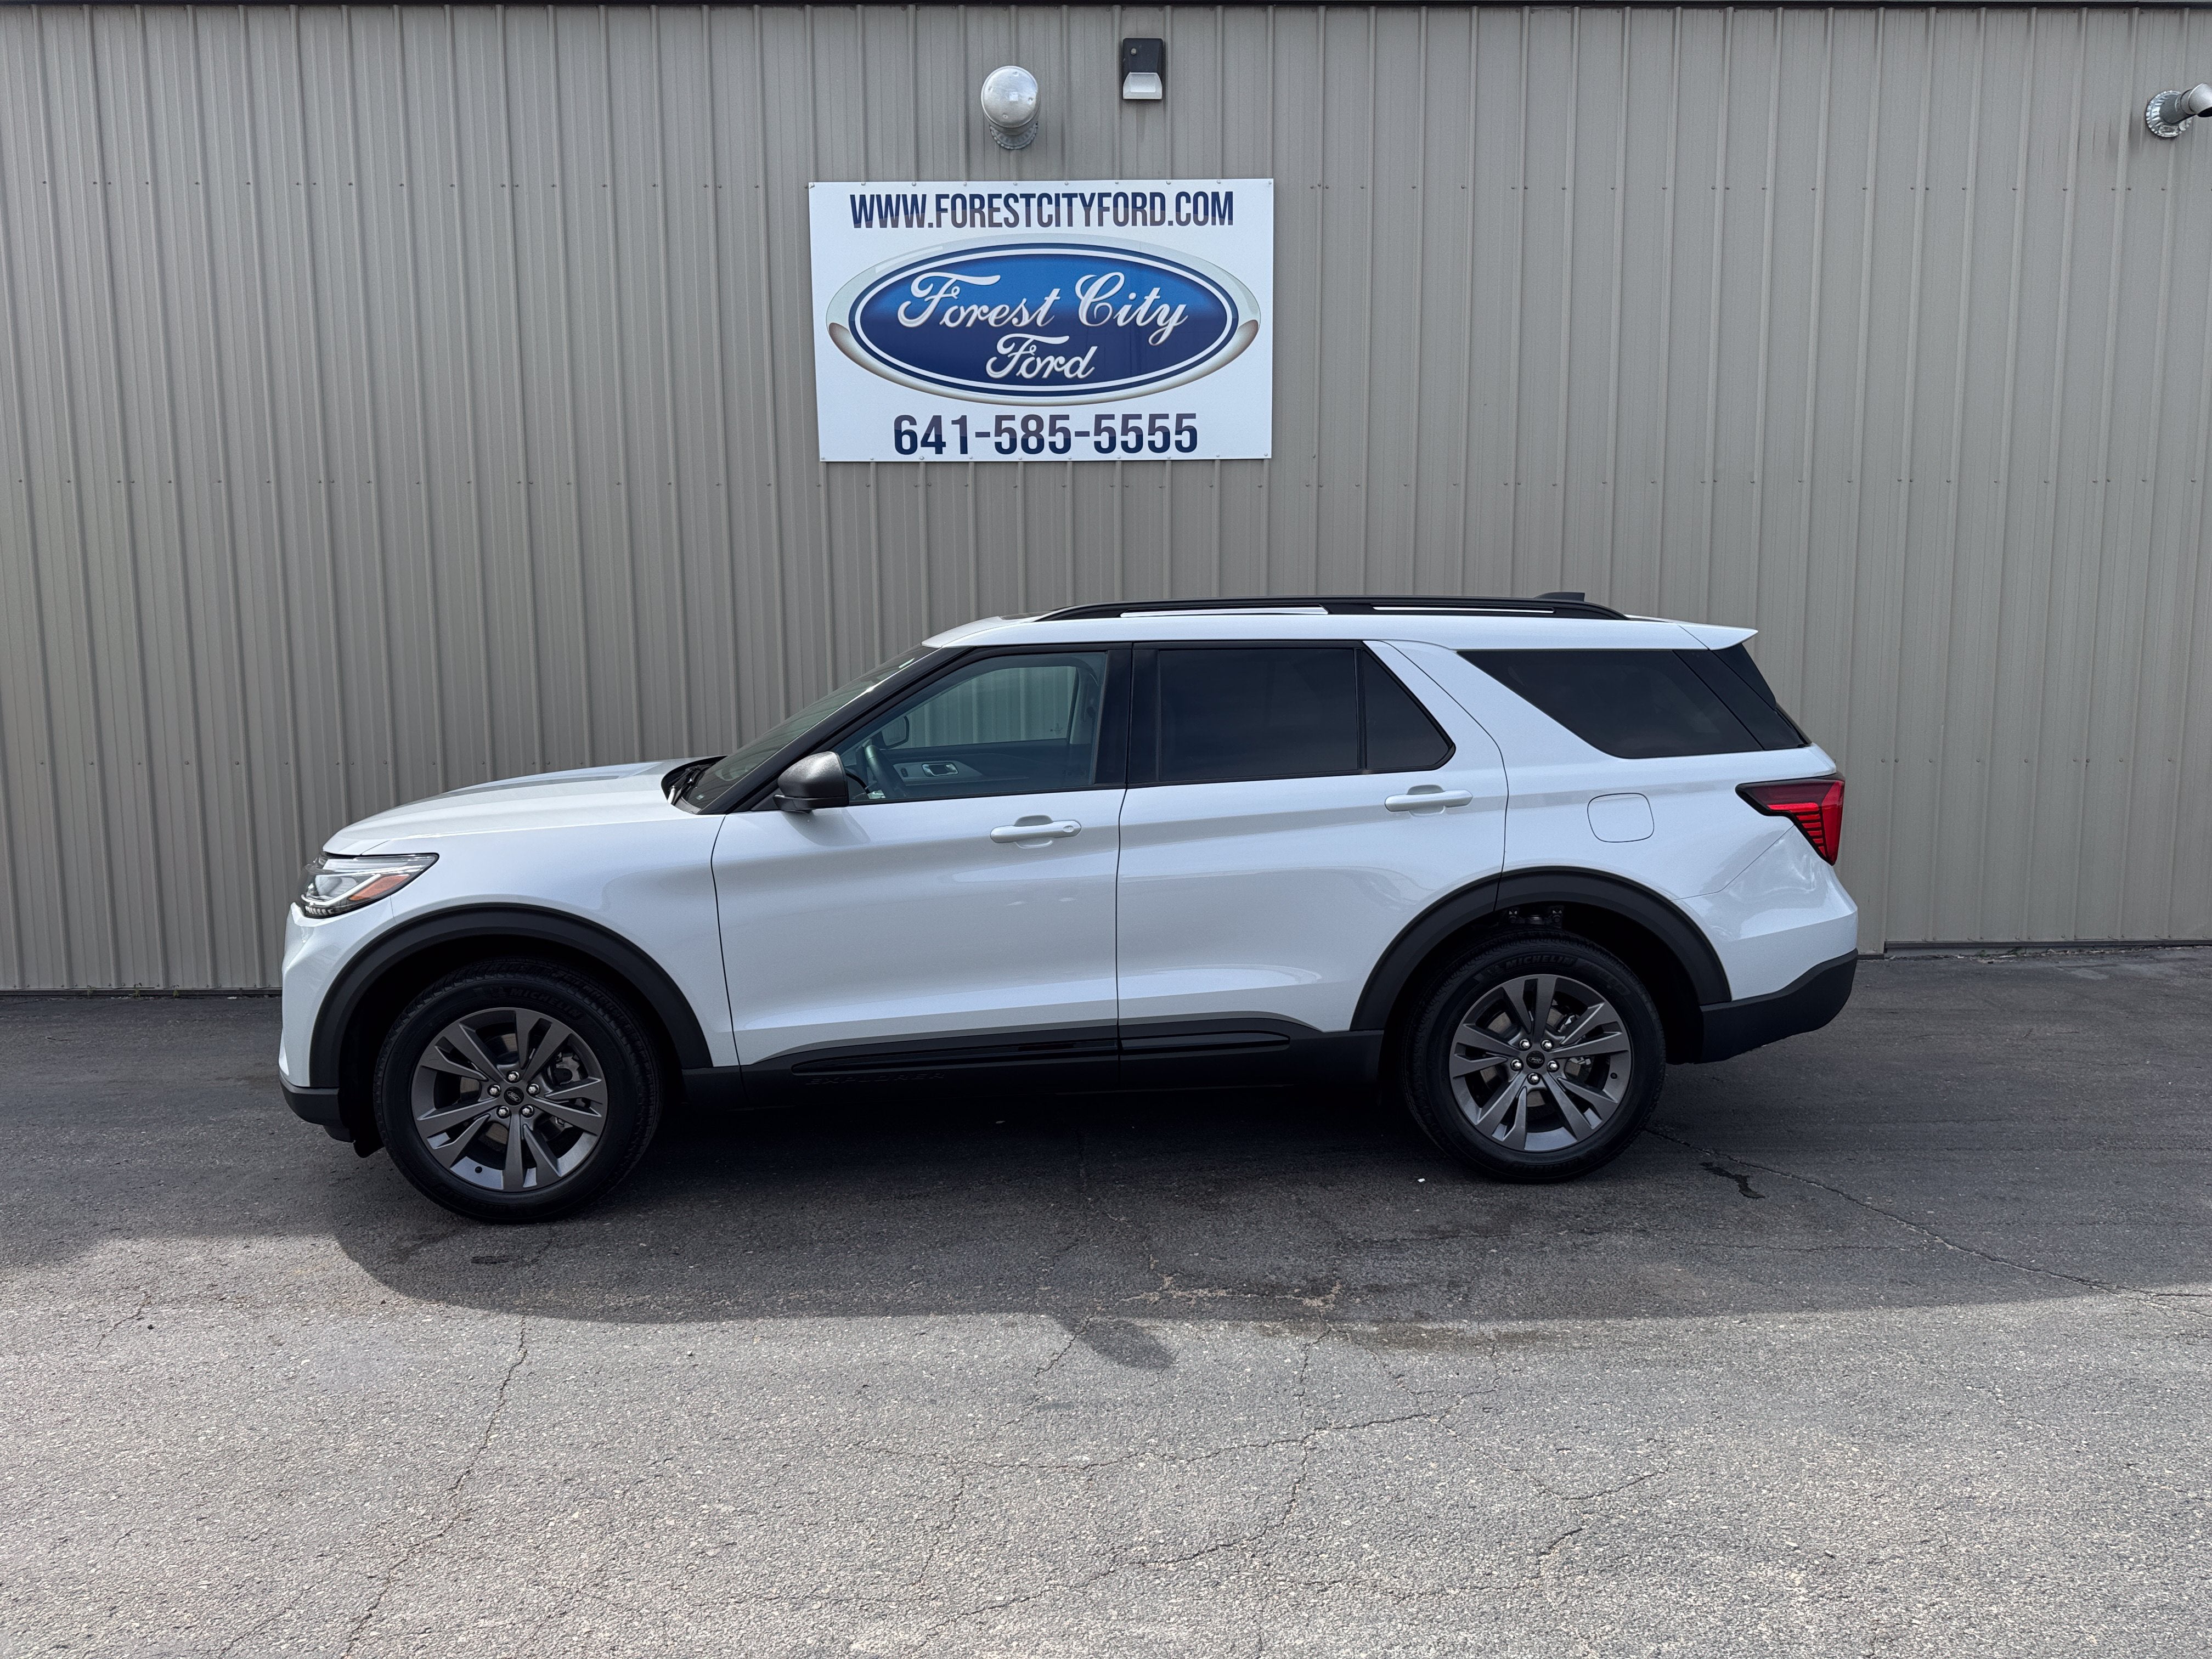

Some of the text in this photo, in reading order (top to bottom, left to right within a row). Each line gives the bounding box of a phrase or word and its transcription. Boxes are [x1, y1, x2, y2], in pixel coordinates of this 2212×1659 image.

[850, 191, 1233, 229] WWW.FORESTCITYFORD.COM
[898, 272, 1188, 346] Forest City
[986, 334, 1097, 379] Ford
[895, 414, 1197, 455] 641-585-5555
[1506, 956, 1574, 968] MICHELIN
[510, 988, 584, 1018] MICHELIN
[805, 1073, 945, 1085] EXPLORER
